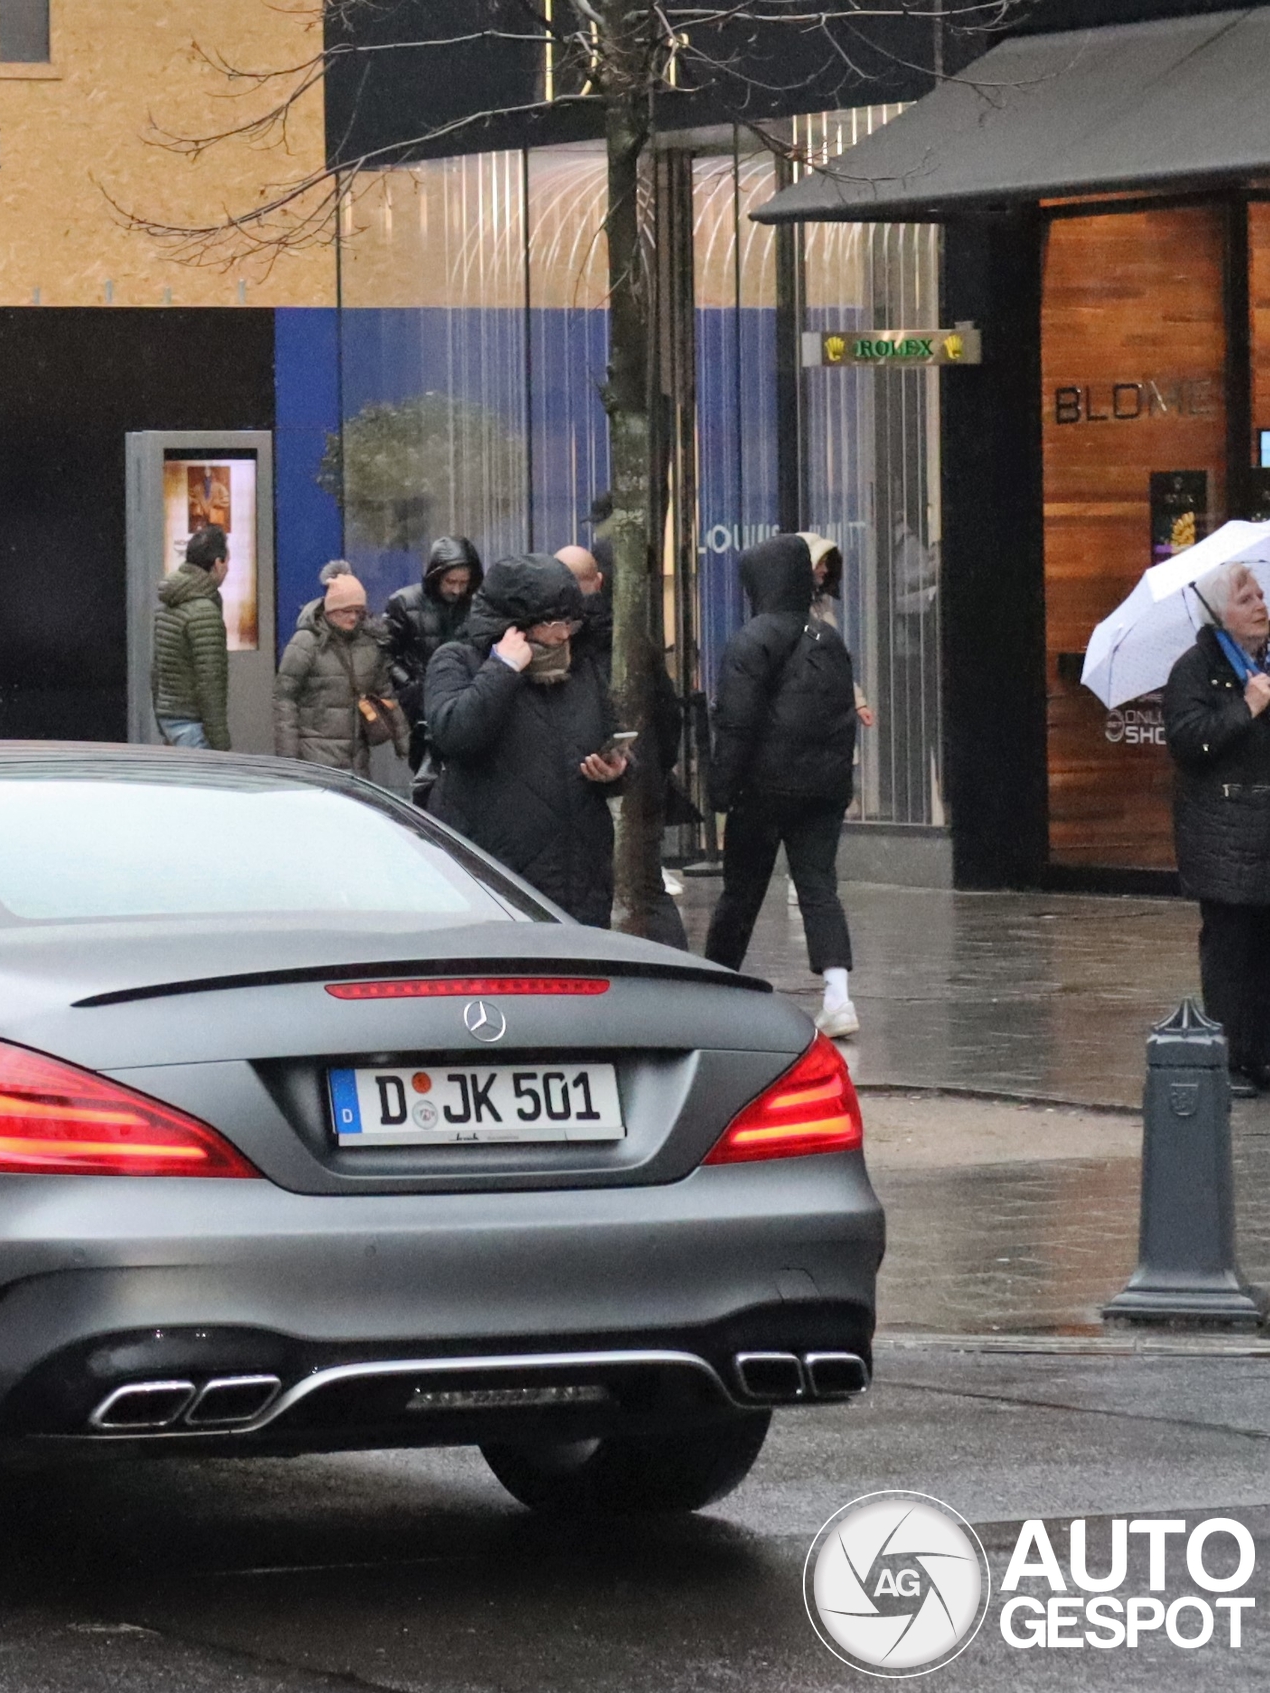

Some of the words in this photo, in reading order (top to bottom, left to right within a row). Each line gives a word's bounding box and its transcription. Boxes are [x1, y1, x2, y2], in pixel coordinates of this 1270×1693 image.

[855, 339, 934, 357] ROLEX
[1125, 709, 1164, 725] ONLI
[1125, 725, 1167, 745] SHO
[375, 1075, 408, 1126] D
[443, 1073, 503, 1124] JK
[512, 1071, 601, 1122] 501
[342, 1108, 353, 1123] D
